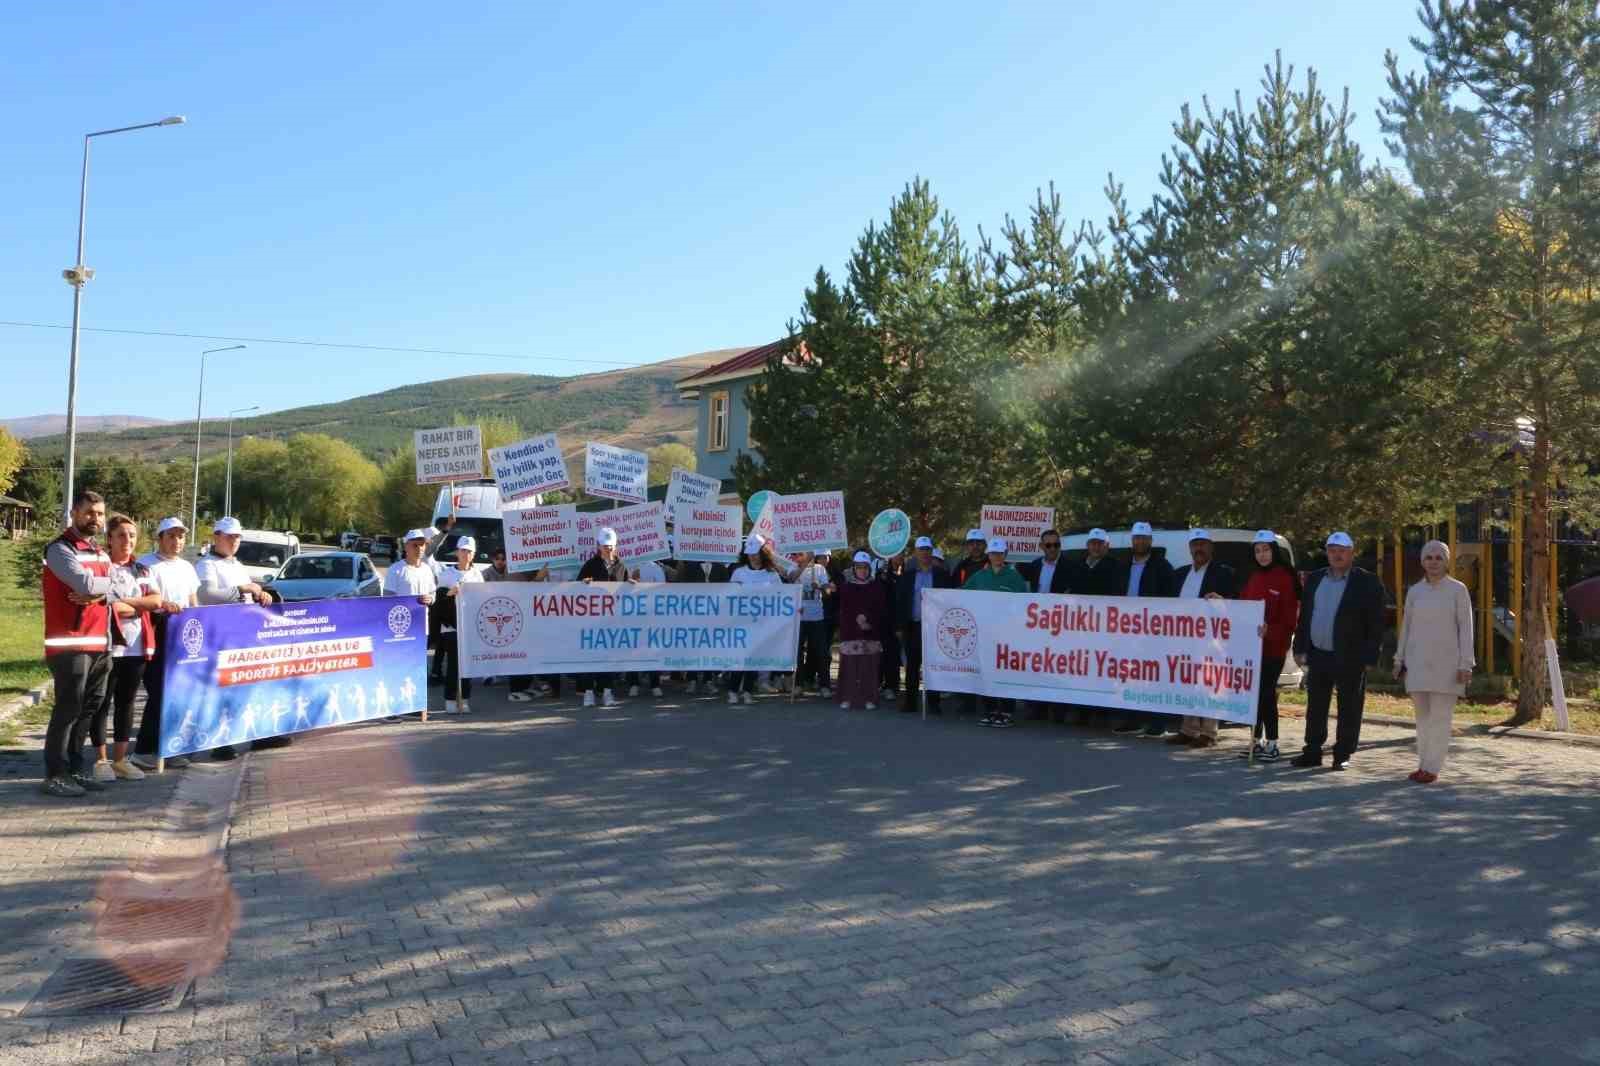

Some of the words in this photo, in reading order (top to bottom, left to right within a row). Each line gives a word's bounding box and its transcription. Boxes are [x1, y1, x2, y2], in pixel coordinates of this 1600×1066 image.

[422, 432, 454, 444] RAHAT
[417, 447, 450, 459] NEFES
[504, 442, 545, 461] Kendine
[497, 467, 511, 479] bir
[502, 475, 545, 494] Harekete
[520, 508, 559, 521] Kalbimiz
[522, 535, 563, 547] Kalbimiz
[533, 593, 647, 617] KANSER'DE
[654, 595, 720, 617] ERKEN
[728, 592, 795, 623] TEŞHİS
[1025, 603, 1101, 635] Sağlıklı
[1106, 606, 1206, 639] Beslenme
[1211, 621, 1230, 640] ve
[580, 627, 642, 649] HAYAT
[649, 627, 748, 649] KURTARIR
[996, 644, 1089, 677] Hareketli
[1094, 651, 1160, 683] Yaşam
[1166, 655, 1253, 694] Yürüyüşü
